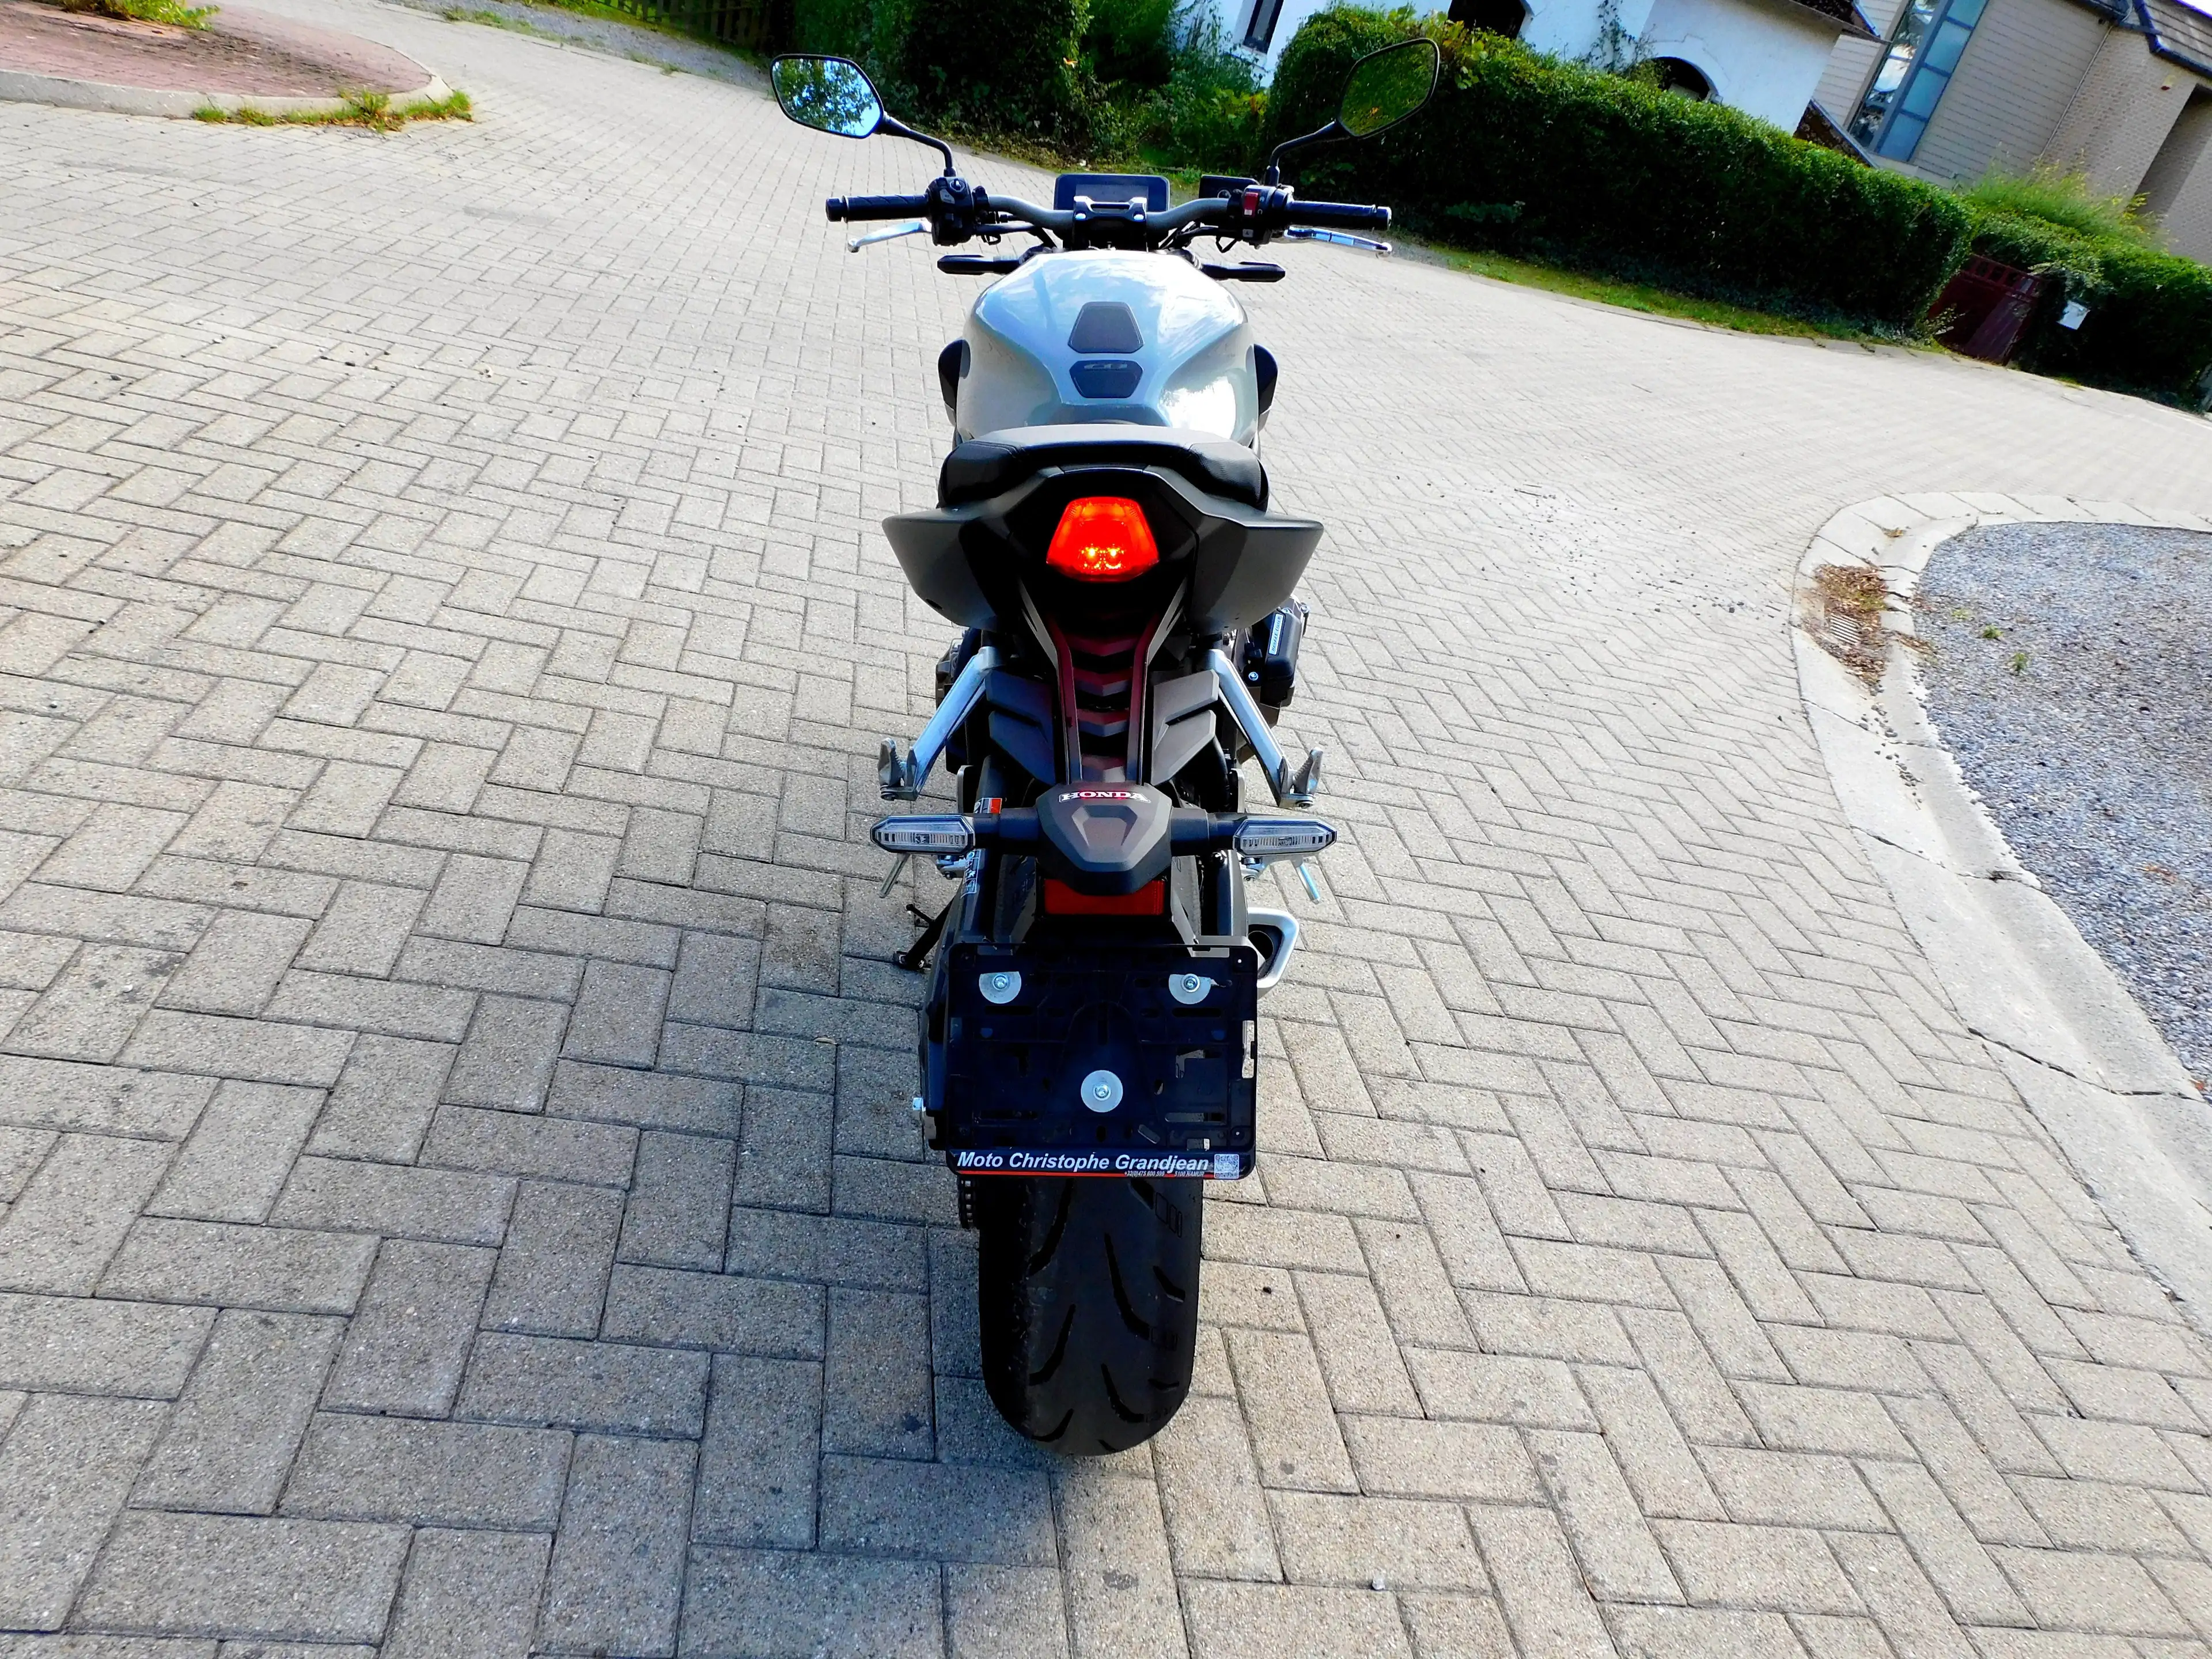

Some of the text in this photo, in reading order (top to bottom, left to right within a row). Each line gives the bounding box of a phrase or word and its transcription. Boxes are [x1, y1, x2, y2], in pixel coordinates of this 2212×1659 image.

[1062, 791, 1149, 802] HONDA
[957, 1152, 1209, 1173] Moto Christophe Grandjean
